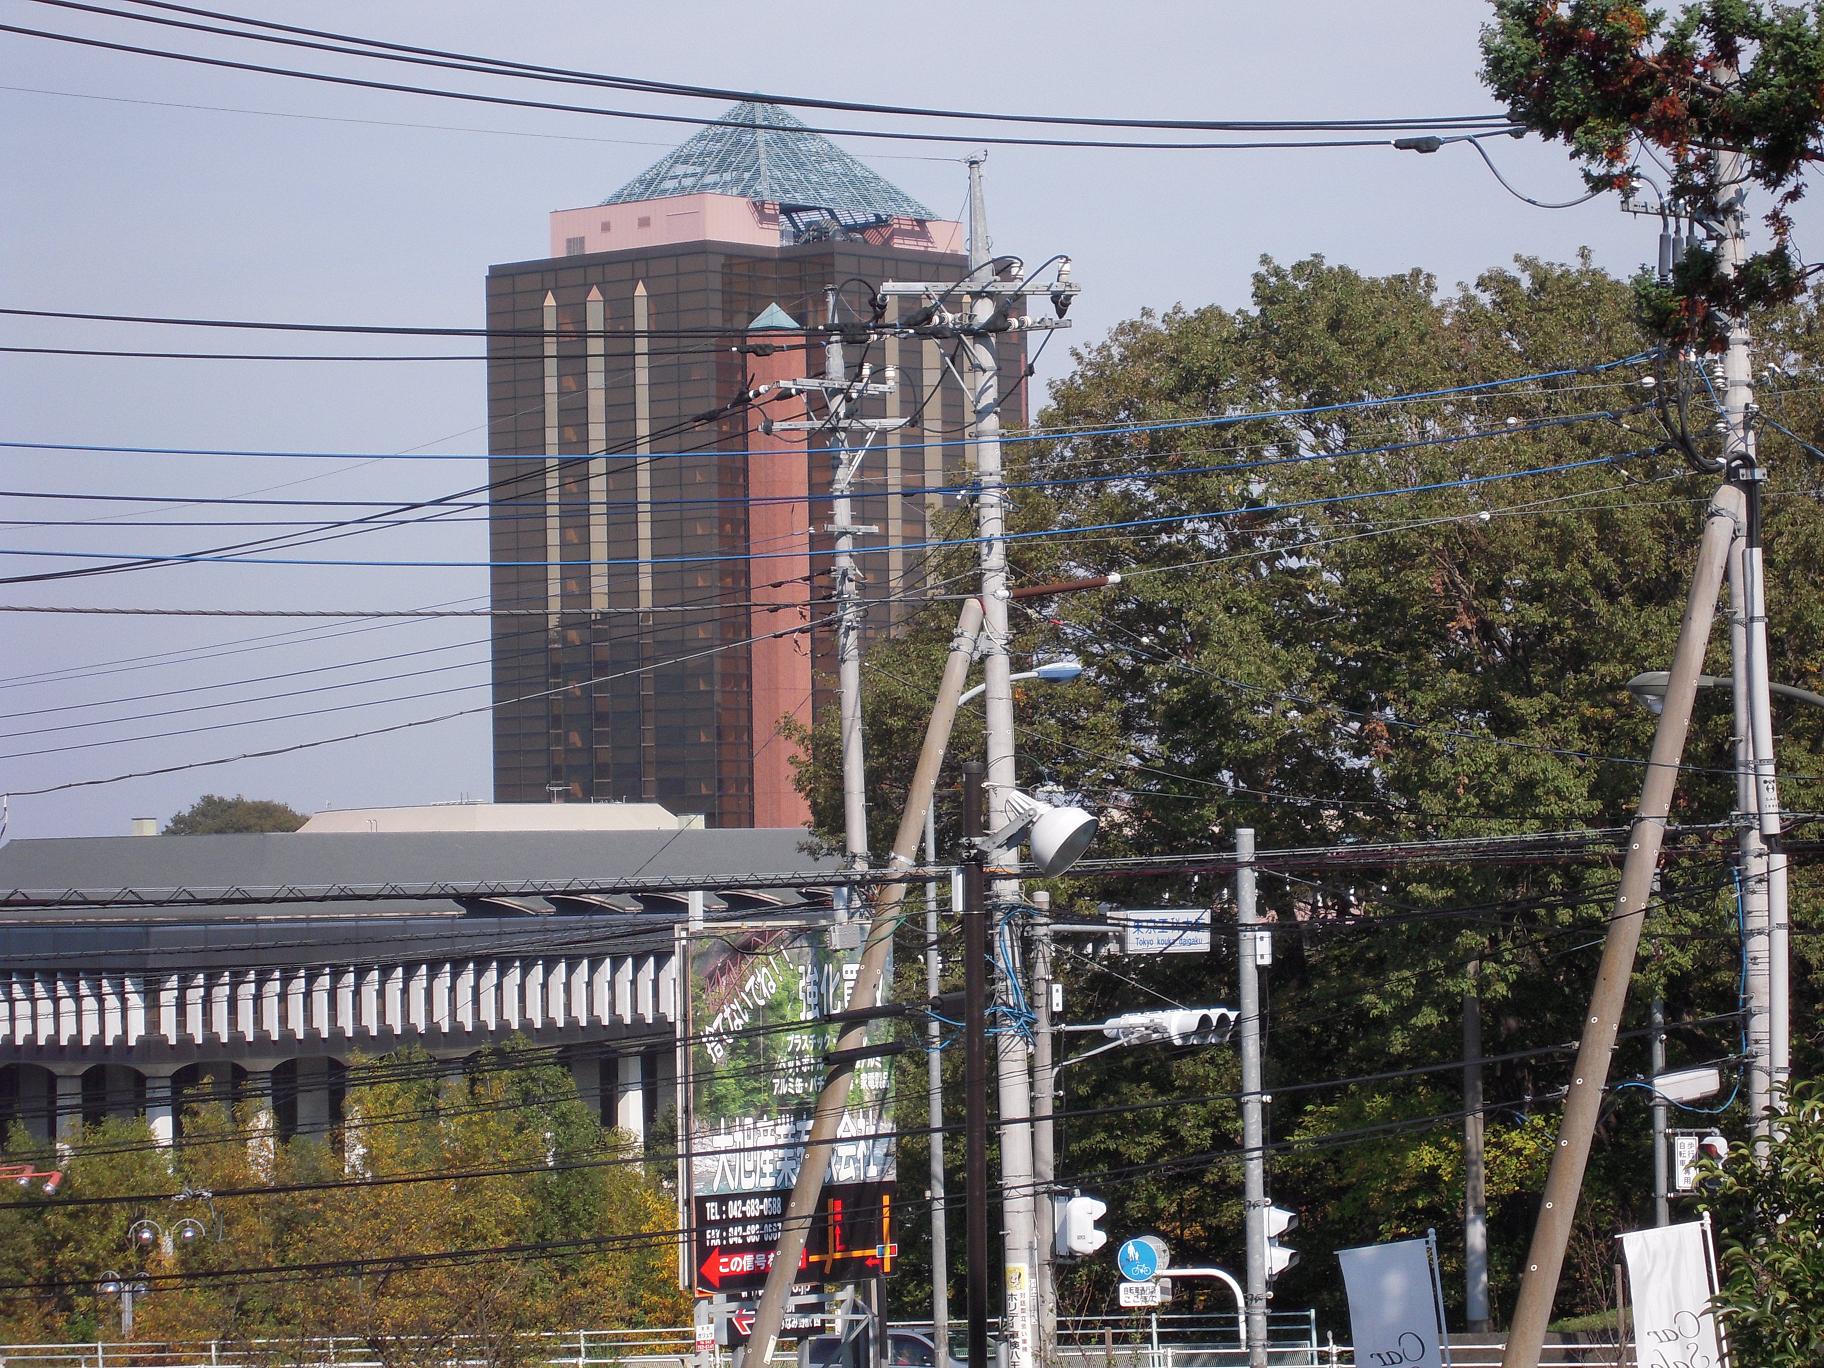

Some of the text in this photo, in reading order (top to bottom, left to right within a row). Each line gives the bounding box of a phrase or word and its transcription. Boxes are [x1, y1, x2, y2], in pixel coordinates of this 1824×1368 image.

[1136, 938, 1154, 947] Tokyo
[799, 963, 884, 1021] 強化買
[728, 1197, 782, 1219] 042-683-0588
